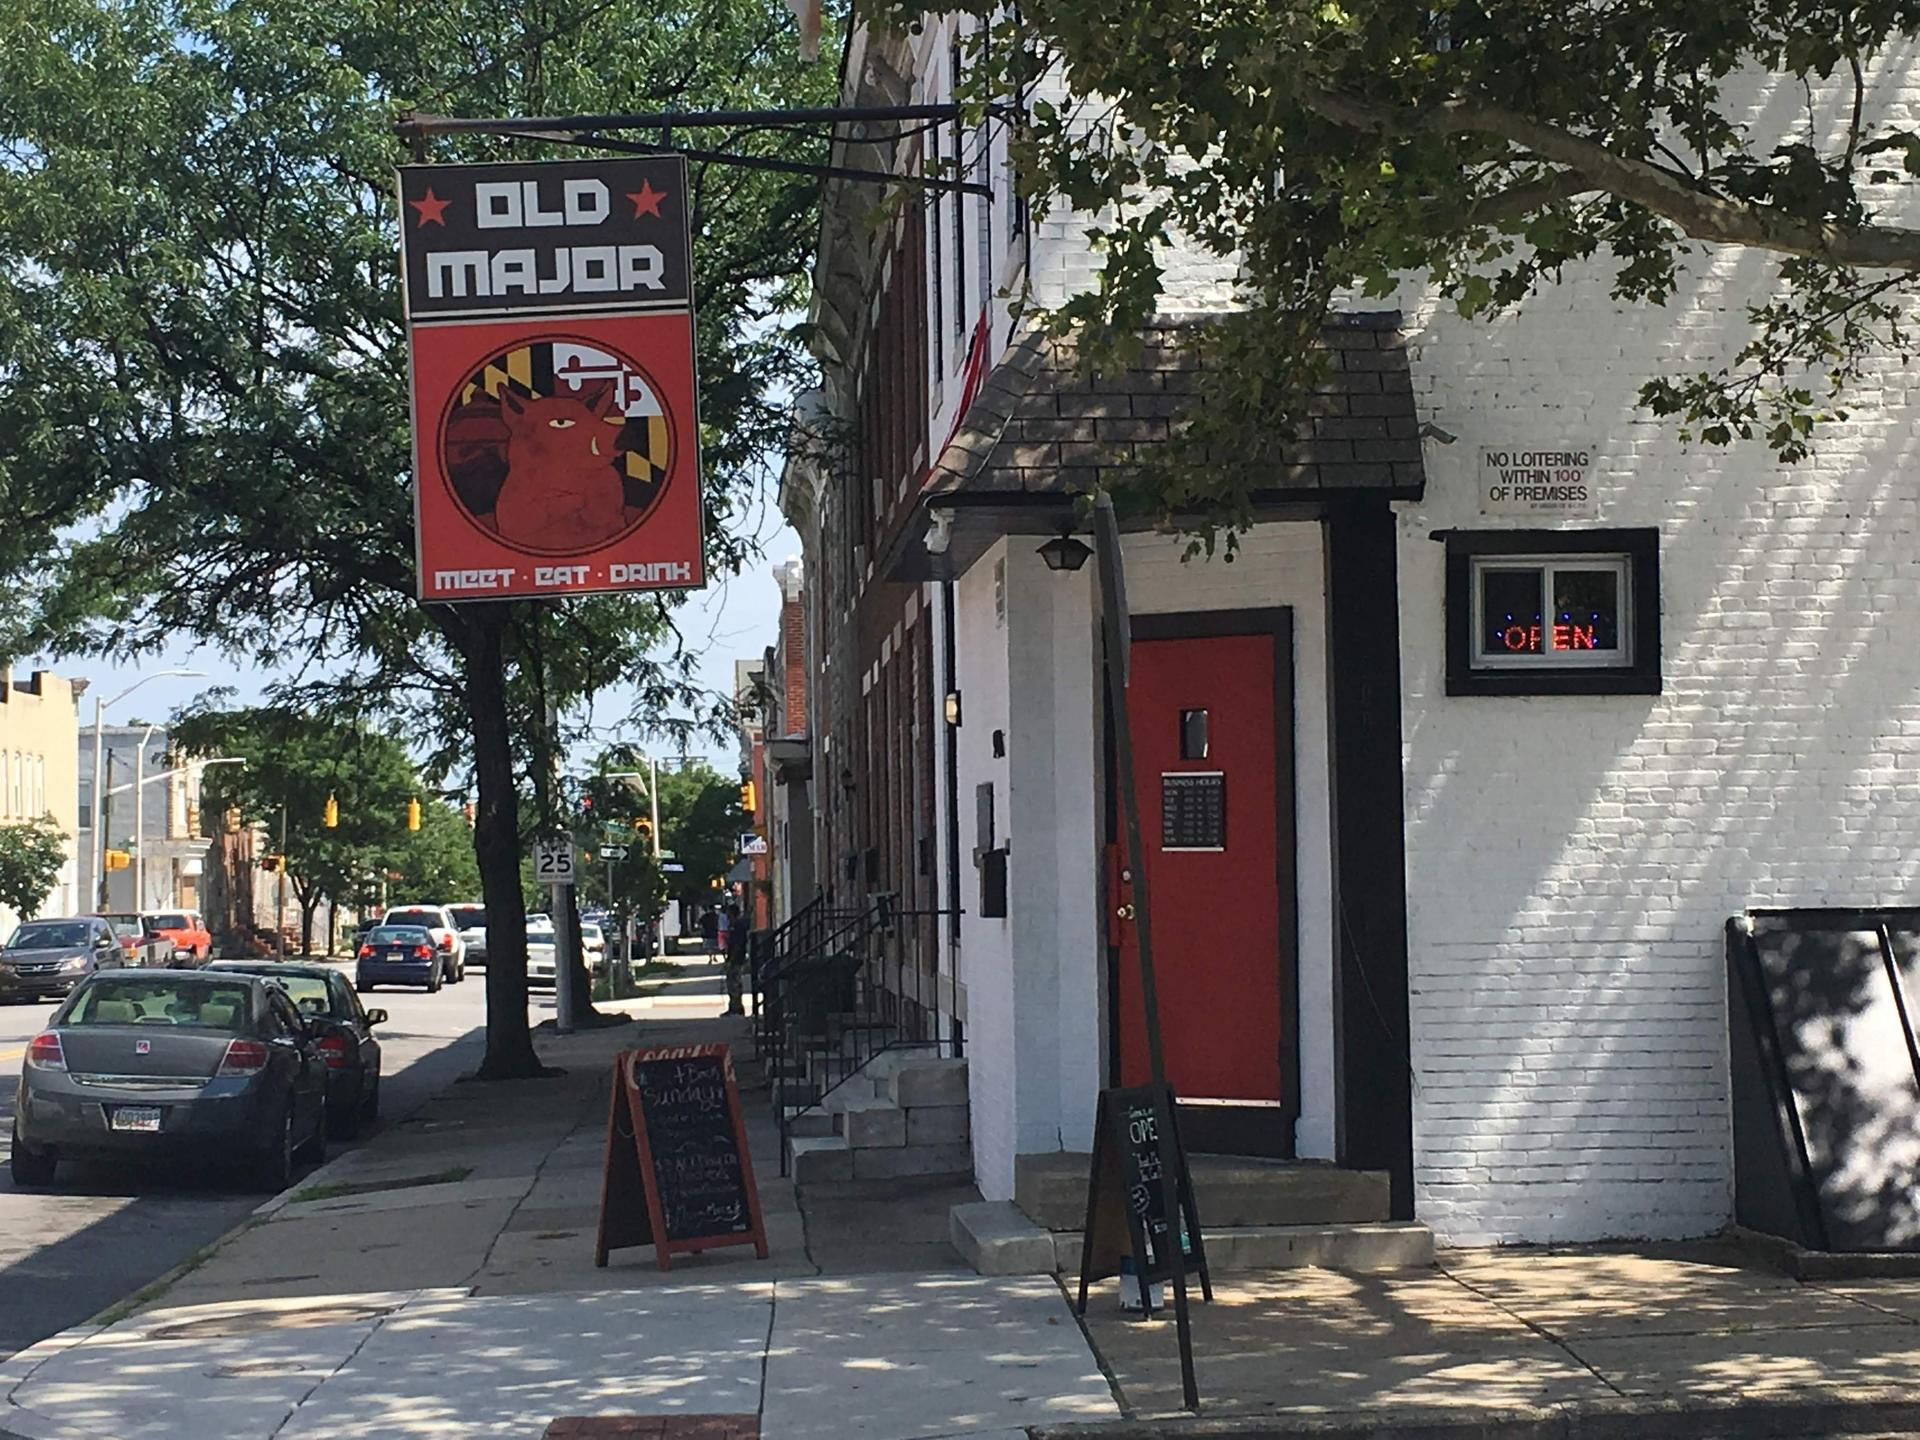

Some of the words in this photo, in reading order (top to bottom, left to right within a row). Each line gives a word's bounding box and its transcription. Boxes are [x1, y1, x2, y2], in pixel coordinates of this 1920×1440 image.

[475, 178, 610, 229] OLD
[426, 244, 666, 298] MAJOR
[1486, 452, 1509, 467] NO
[1513, 452, 1589, 467] LOITERING
[1500, 470, 1551, 484] WITHIN
[1489, 486, 1510, 501] OF
[1514, 486, 1588, 501] PREMISES
[434, 568, 516, 590] MEET
[534, 565, 591, 586] EAT
[609, 561, 691, 584] DRINK
[1503, 624, 1594, 650] OPEN
[540, 853, 571, 873] 25
